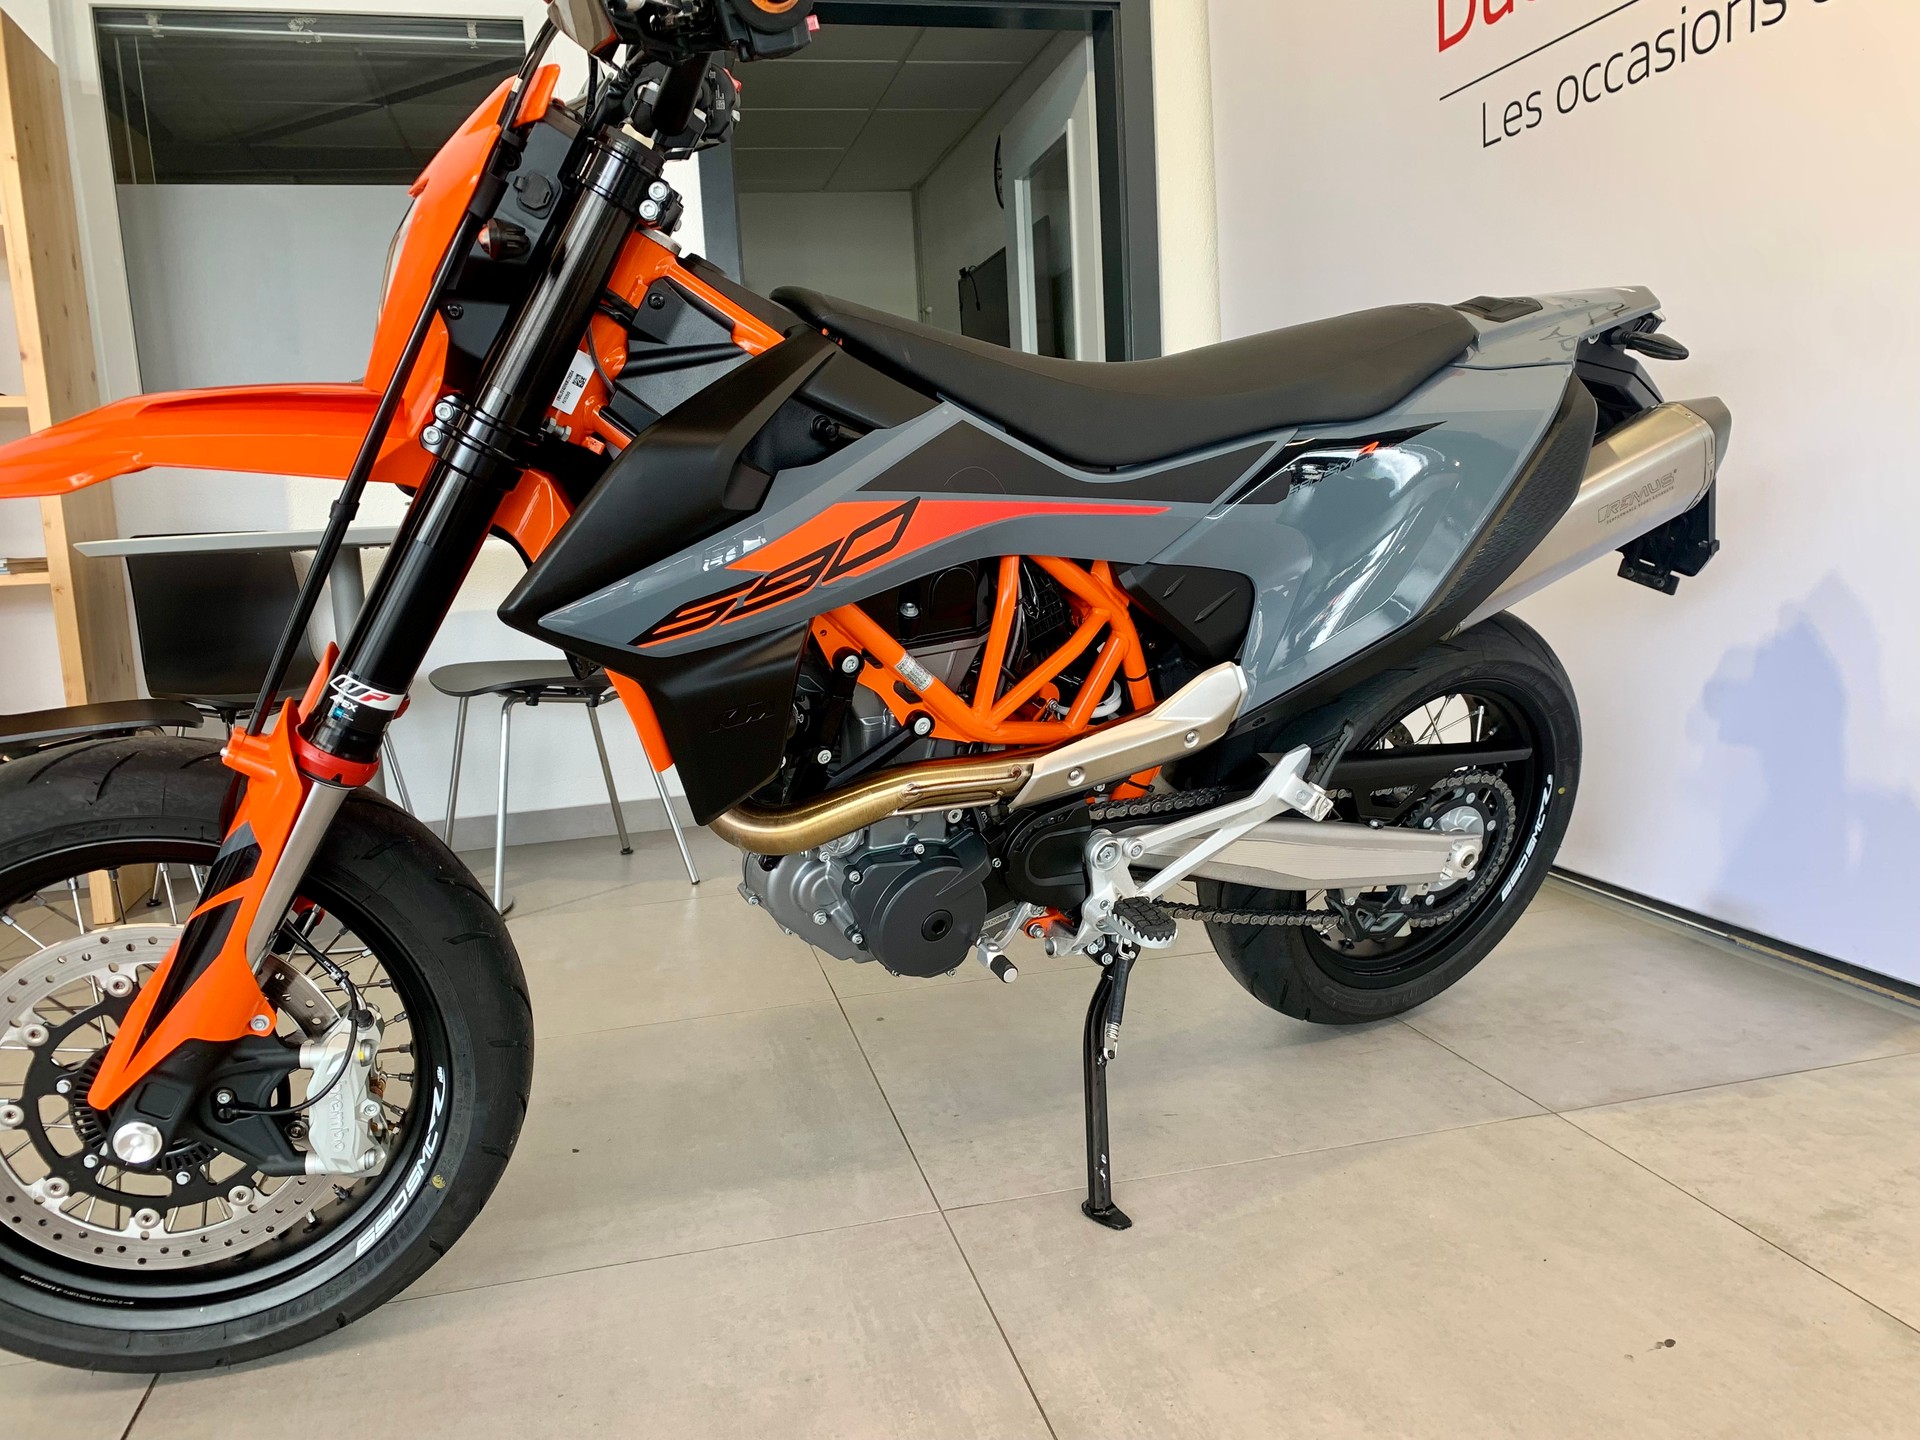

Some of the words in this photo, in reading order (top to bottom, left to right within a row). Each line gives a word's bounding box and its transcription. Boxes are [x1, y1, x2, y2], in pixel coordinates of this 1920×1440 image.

[1482, 90, 1543, 148] Les
[1556, 0, 1788, 115] occasions
[1598, 472, 1676, 524] REMUS
[626, 495, 922, 648] 690
[329, 694, 359, 713] APEX
[327, 1078, 350, 1155] brembo
